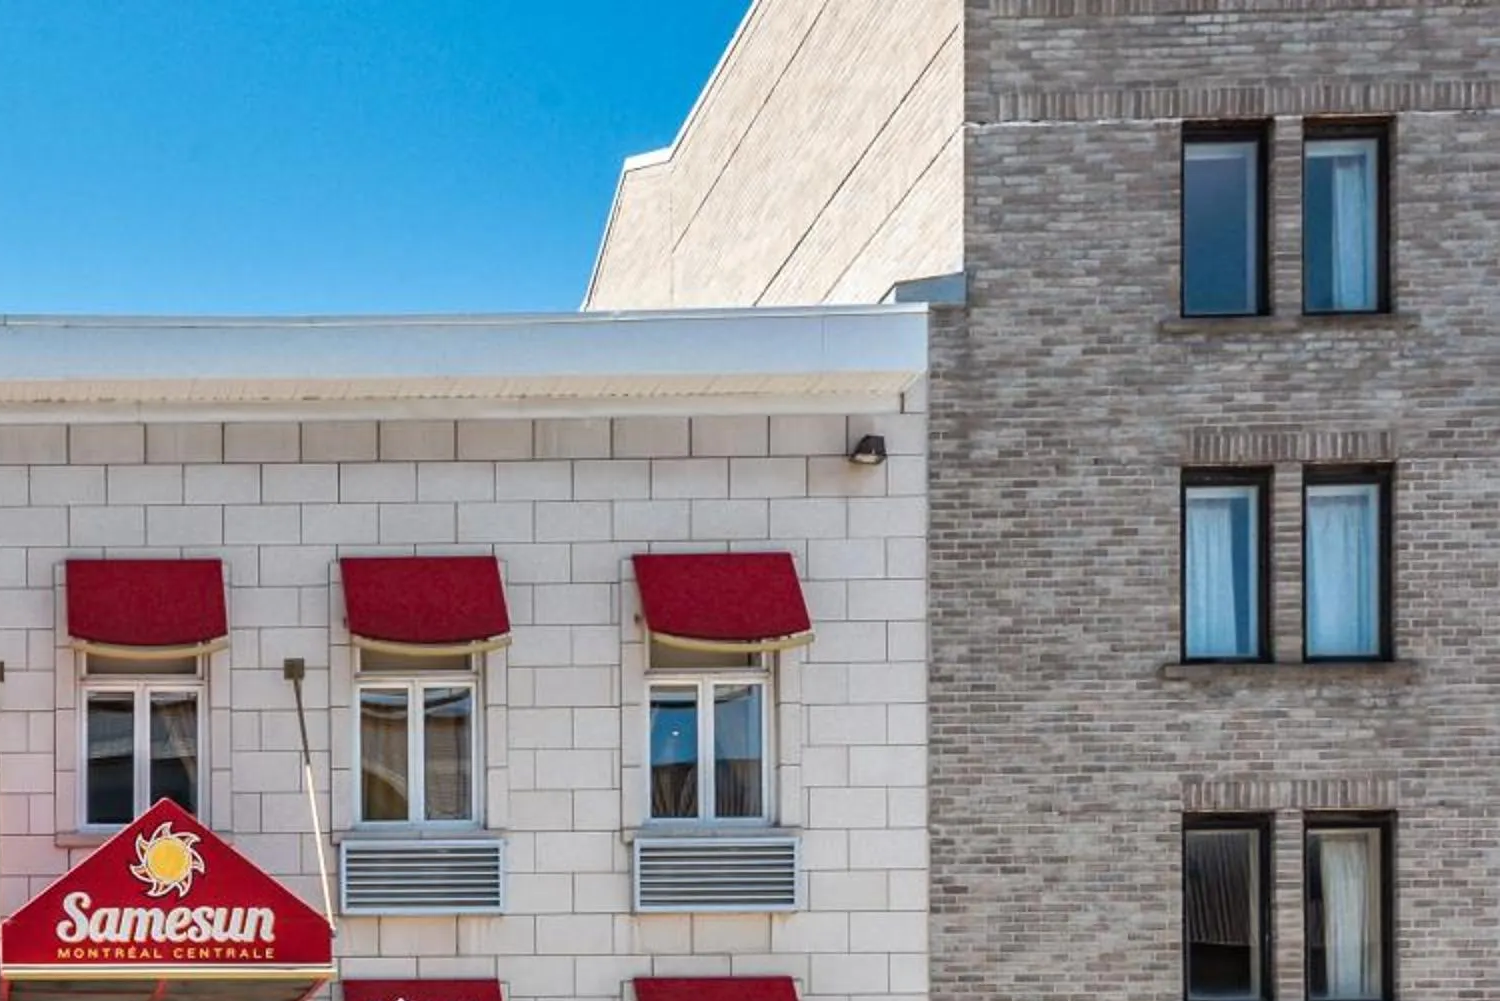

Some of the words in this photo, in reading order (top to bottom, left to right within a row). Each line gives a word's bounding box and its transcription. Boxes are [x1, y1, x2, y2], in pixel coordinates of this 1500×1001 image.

[56, 892, 276, 943] Samesun
[57, 946, 163, 959] MONTRÉAL
[173, 948, 275, 959] CENTRALE
